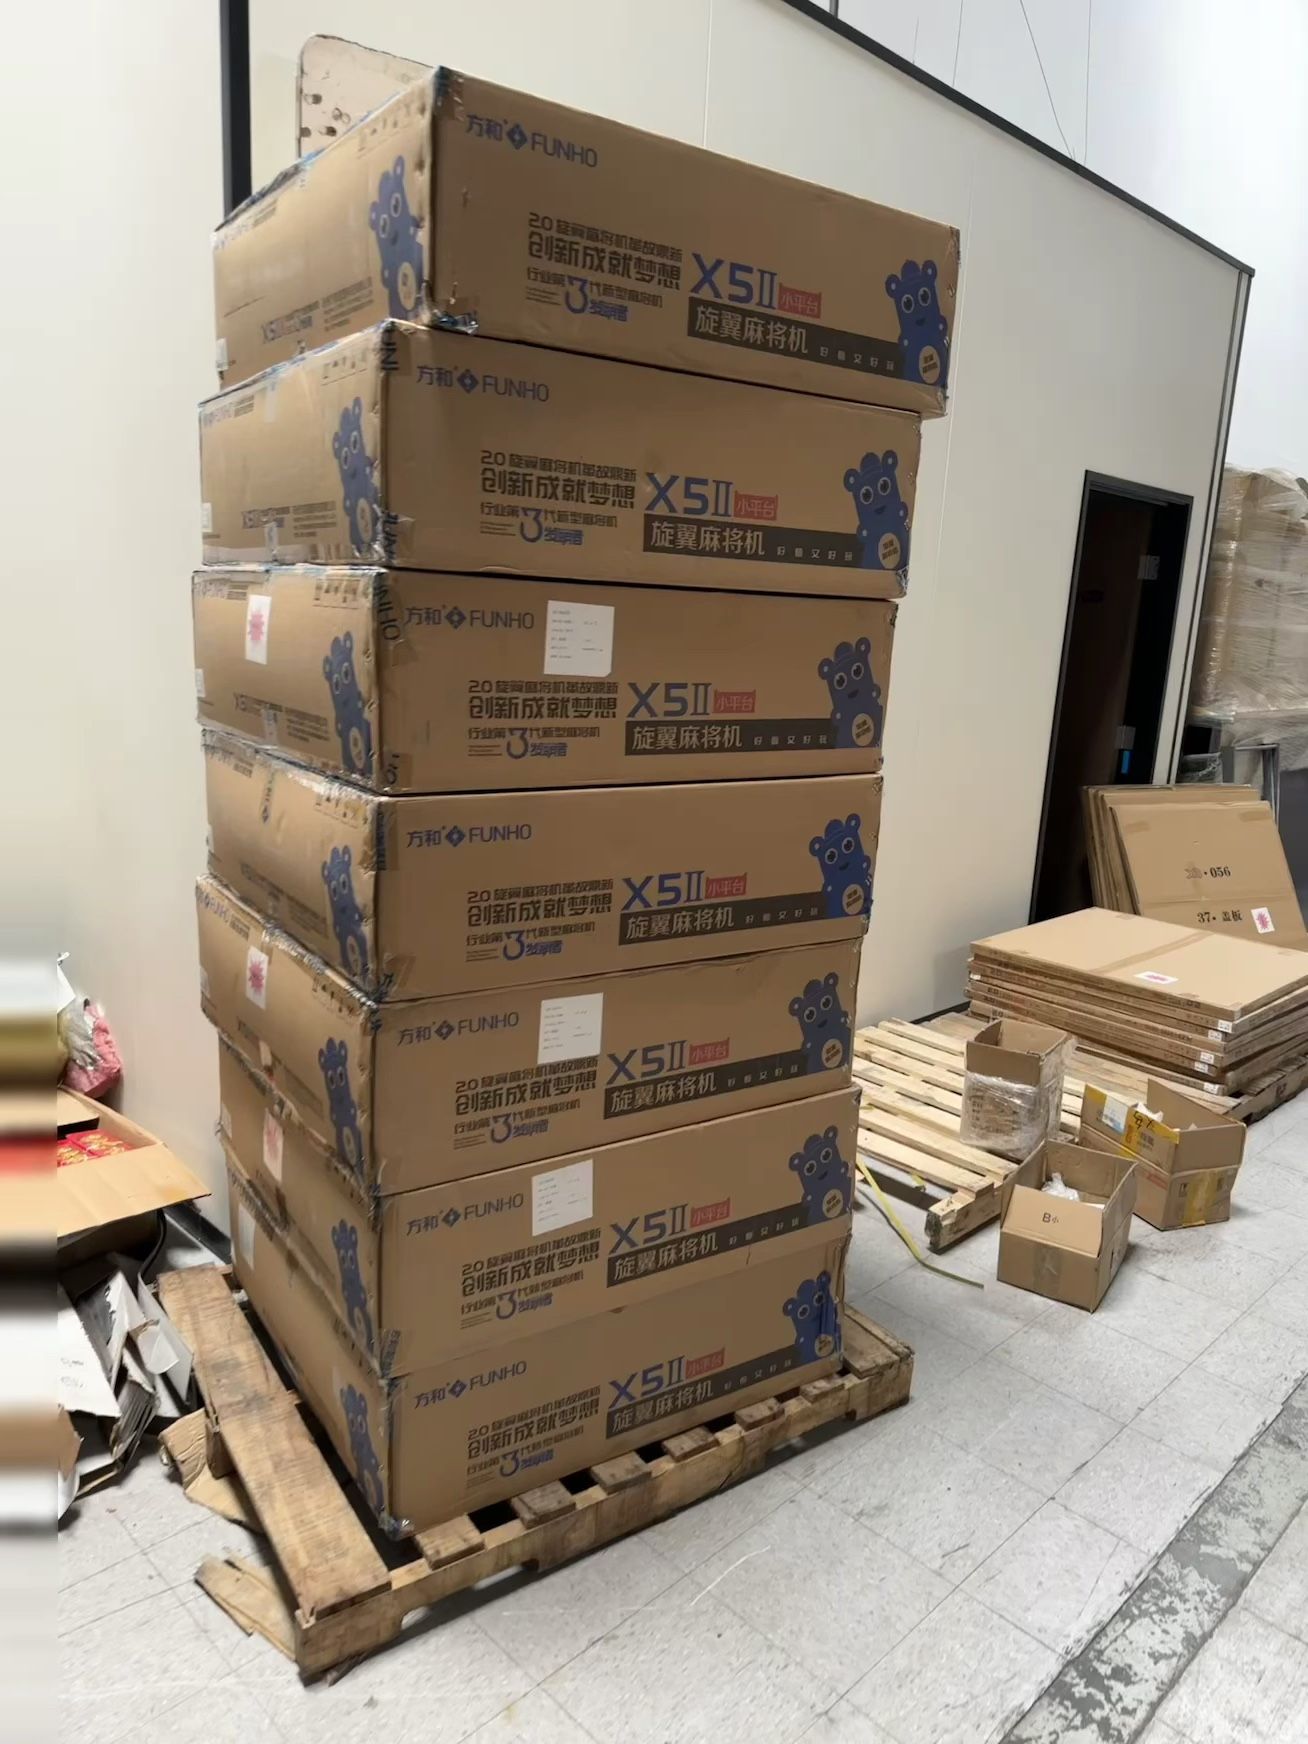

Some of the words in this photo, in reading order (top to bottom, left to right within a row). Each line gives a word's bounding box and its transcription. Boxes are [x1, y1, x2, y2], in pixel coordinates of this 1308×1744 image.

[466, 115, 503, 142] 方和
[531, 133, 598, 168] FUNHO
[528, 231, 681, 290] 创新成就梦想
[782, 292, 820, 316] 小平台
[696, 304, 808, 354] 旋翼麻将机
[416, 364, 453, 387] 方和
[482, 374, 549, 402] FUNHO
[481, 467, 635, 509] 创新成就梦想
[736, 497, 776, 519] 小平台
[651, 521, 765, 556] 旋翼麻将机
[404, 607, 441, 626] 方和
[470, 610, 534, 629] FUNHO
[469, 696, 617, 719] 创新成就梦想
[716, 694, 754, 712] 小平台
[632, 725, 742, 750] 旋翼麻将机
[407, 829, 441, 848] 方和
[469, 823, 532, 843] FUNHO
[468, 892, 612, 927] 创新成就梦想
[626, 906, 734, 940] 旋翼麻将机
[398, 1026, 431, 1046] 方和
[458, 1011, 519, 1036] FUNHO
[611, 1071, 717, 1113] 旋翼麻将机
[406, 1215, 439, 1236] 方和
[463, 1192, 524, 1221] FUNHO
[414, 1388, 446, 1410] 方和
[469, 1360, 527, 1391] FUNHO
